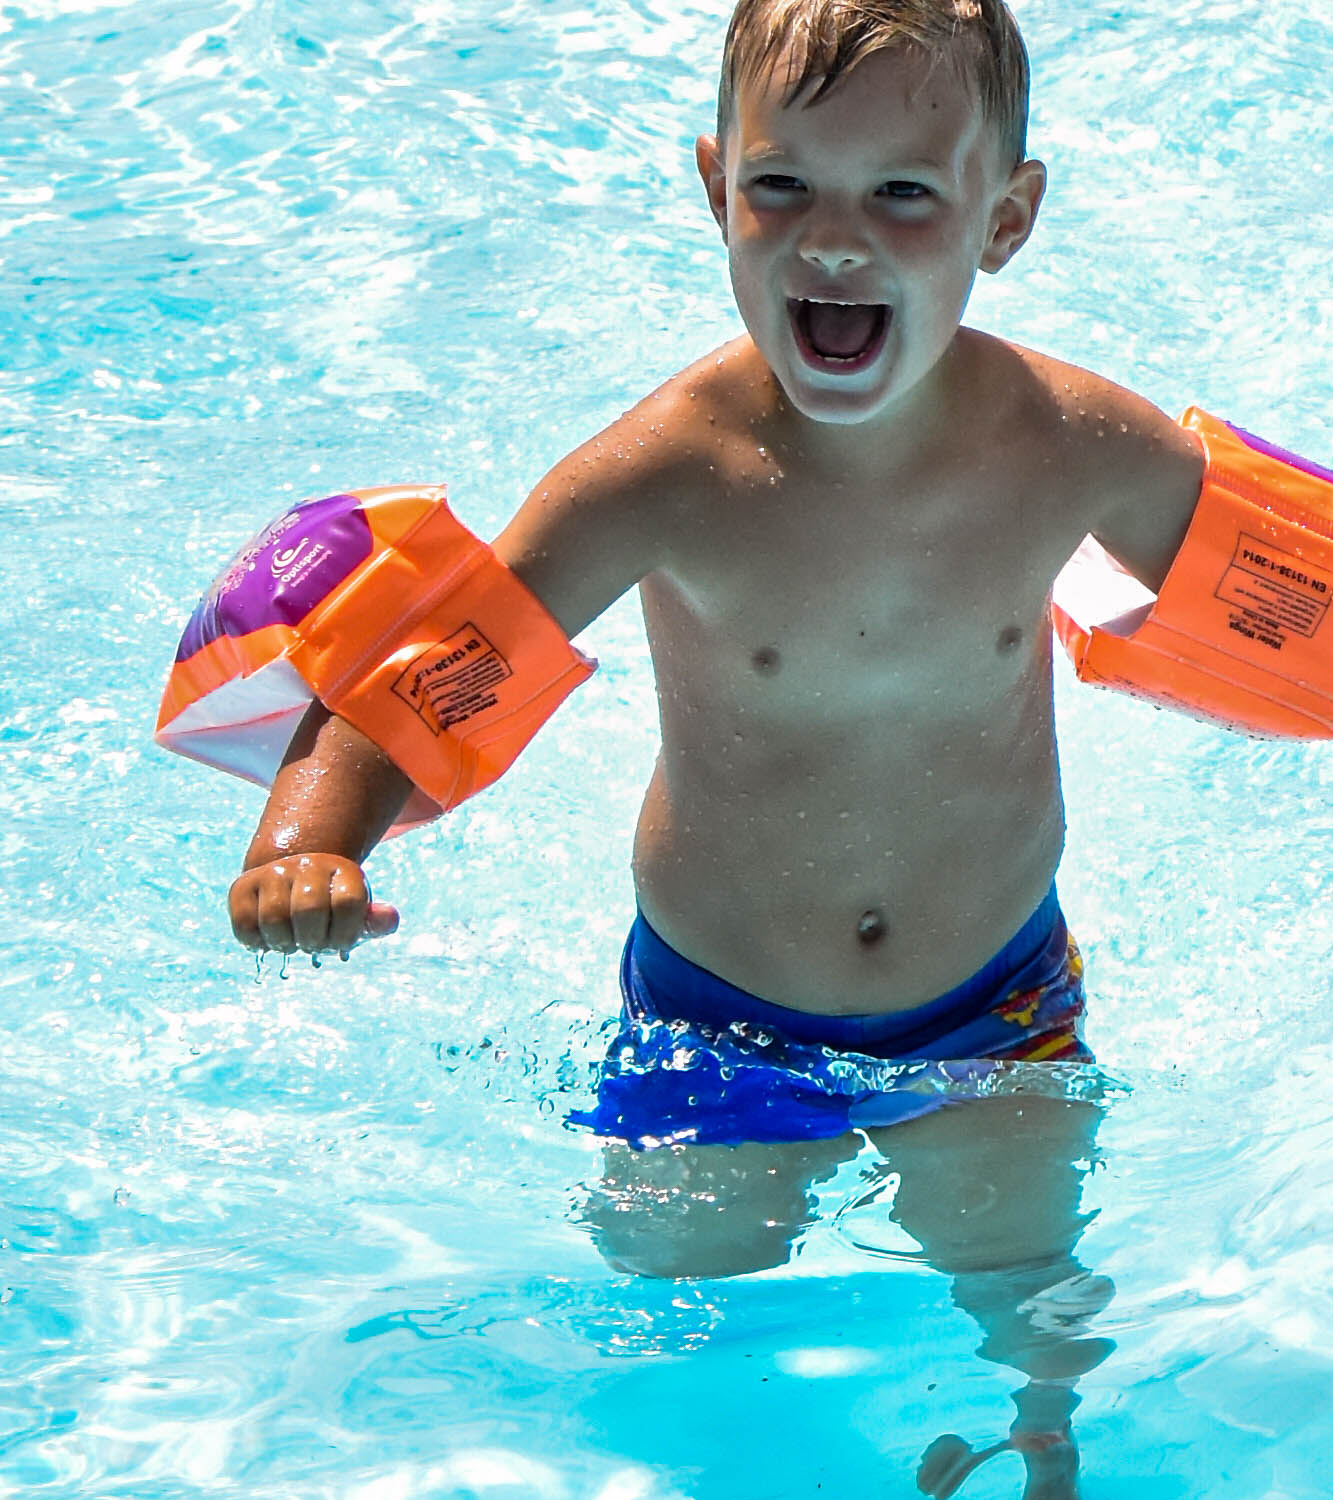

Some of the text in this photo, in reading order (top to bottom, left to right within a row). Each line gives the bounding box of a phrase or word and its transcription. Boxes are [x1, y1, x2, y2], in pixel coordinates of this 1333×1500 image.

[280, 543, 326, 583] Optisport
[1310, 579, 1328, 594] EN
[1228, 620, 1256, 640] Wings
[1255, 633, 1282, 651] Water
